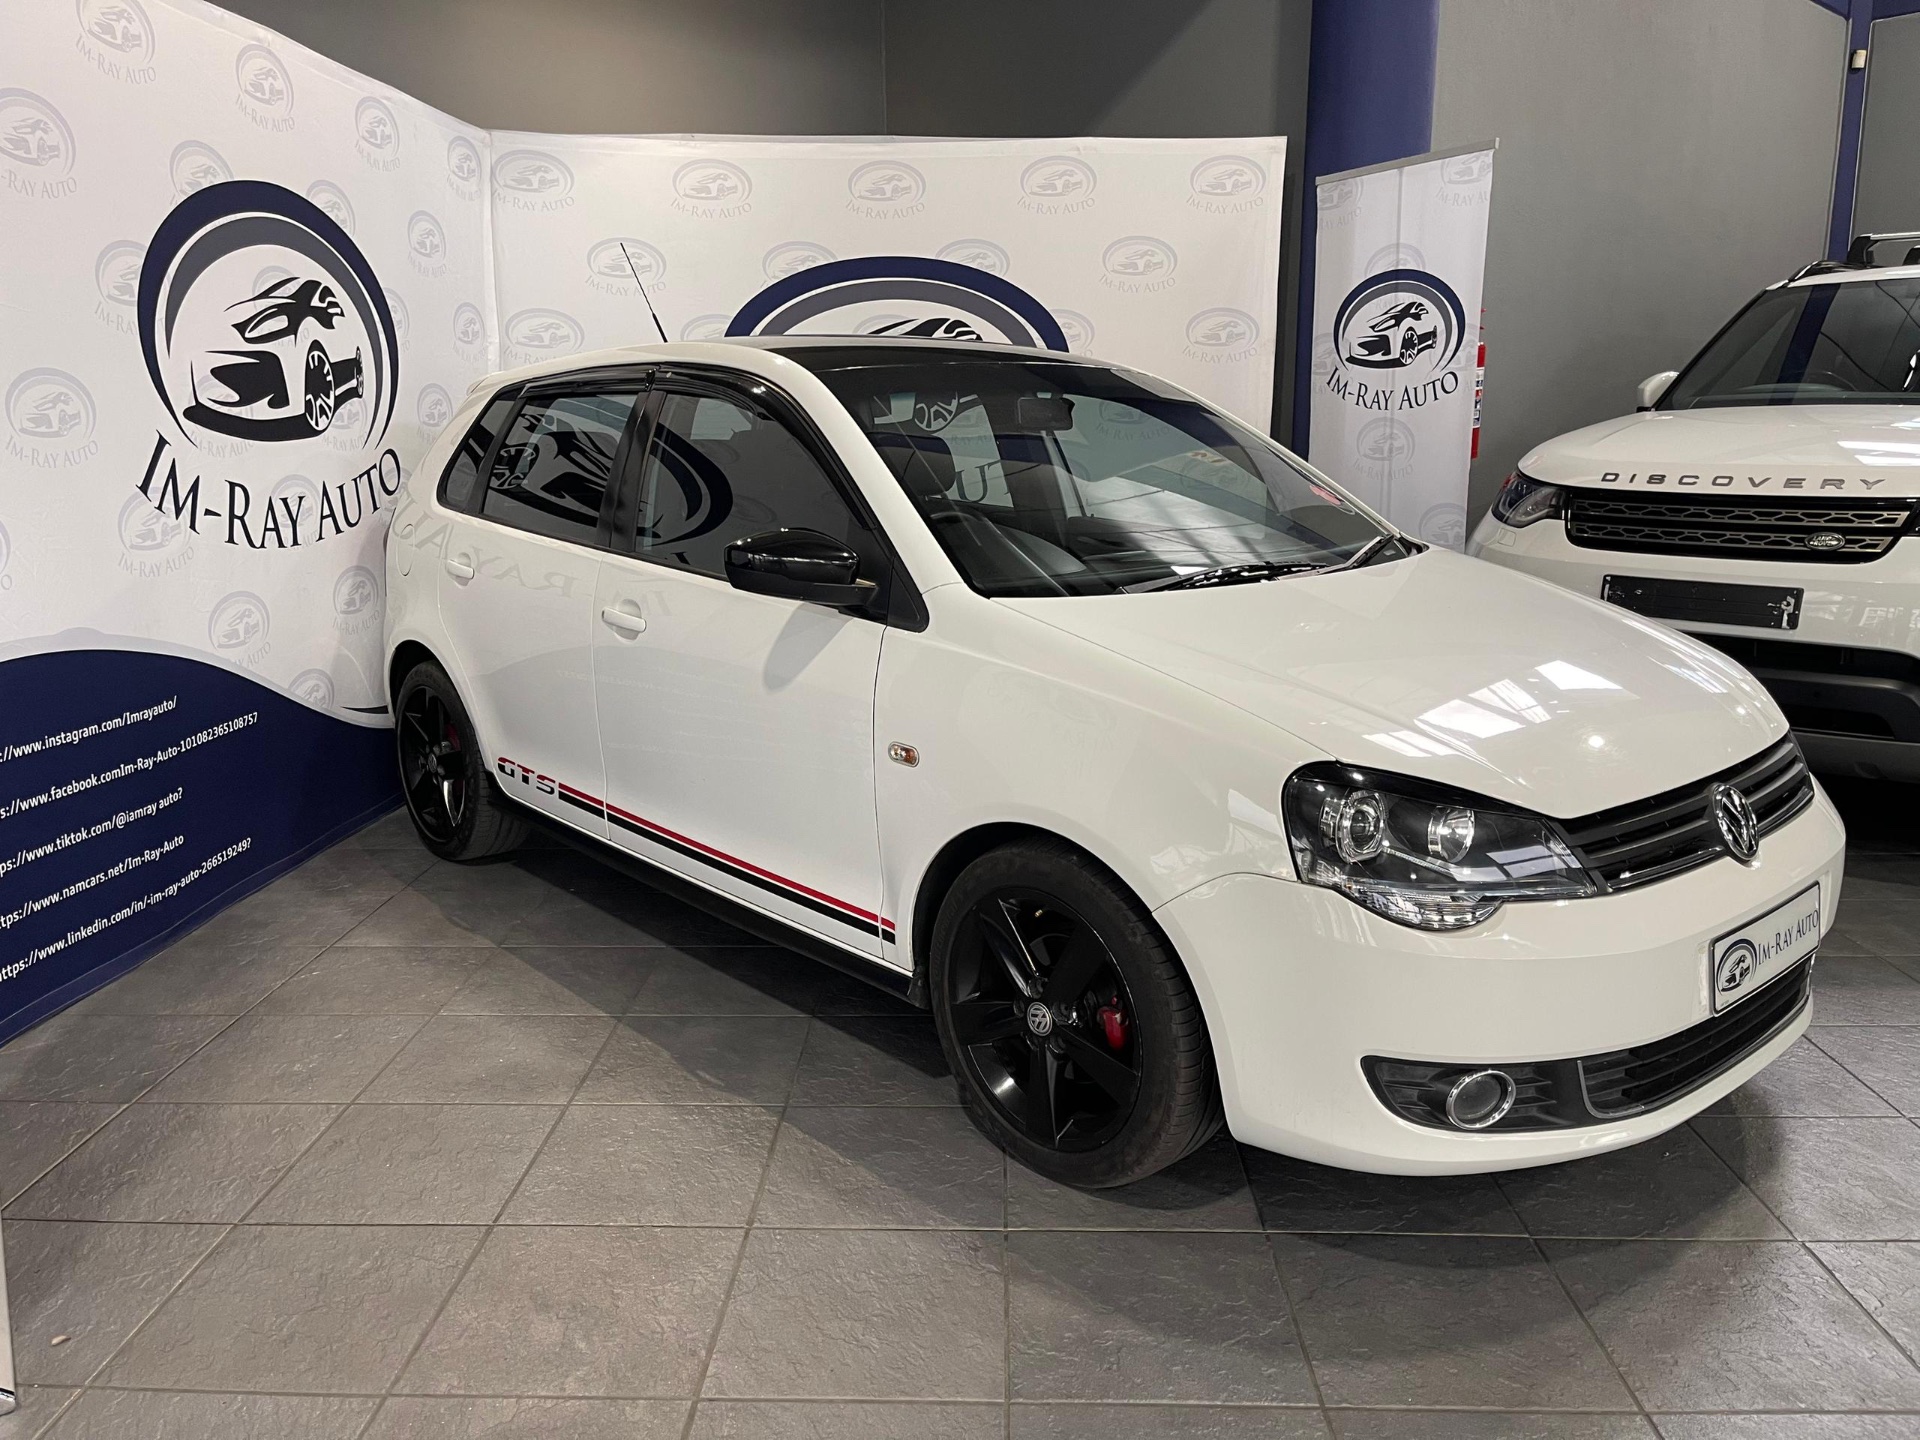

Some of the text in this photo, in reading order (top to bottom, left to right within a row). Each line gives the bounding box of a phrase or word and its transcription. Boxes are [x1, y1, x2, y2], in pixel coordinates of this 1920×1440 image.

[41, 177, 77, 199] AUTO
[670, 197, 752, 219] IM-RAY AUTO
[845, 199, 926, 220] IM-RAY AUTO
[1016, 195, 1096, 216] IM-RAY AUTO
[1186, 194, 1265, 215] IM-RAY AUTO
[1100, 274, 1176, 294] IM-RAY AUTO
[1326, 366, 1394, 411] IM-RAY
[1397, 371, 1459, 411] AUTO
[5, 434, 99, 468] IM-RAY AUTO
[135, 429, 401, 549] IM-RAY AUTO
[1601, 472, 1885, 490] DISCOVERY
[498, 756, 556, 796] GTS
[1757, 908, 1819, 966] IM-RAY AUTO
